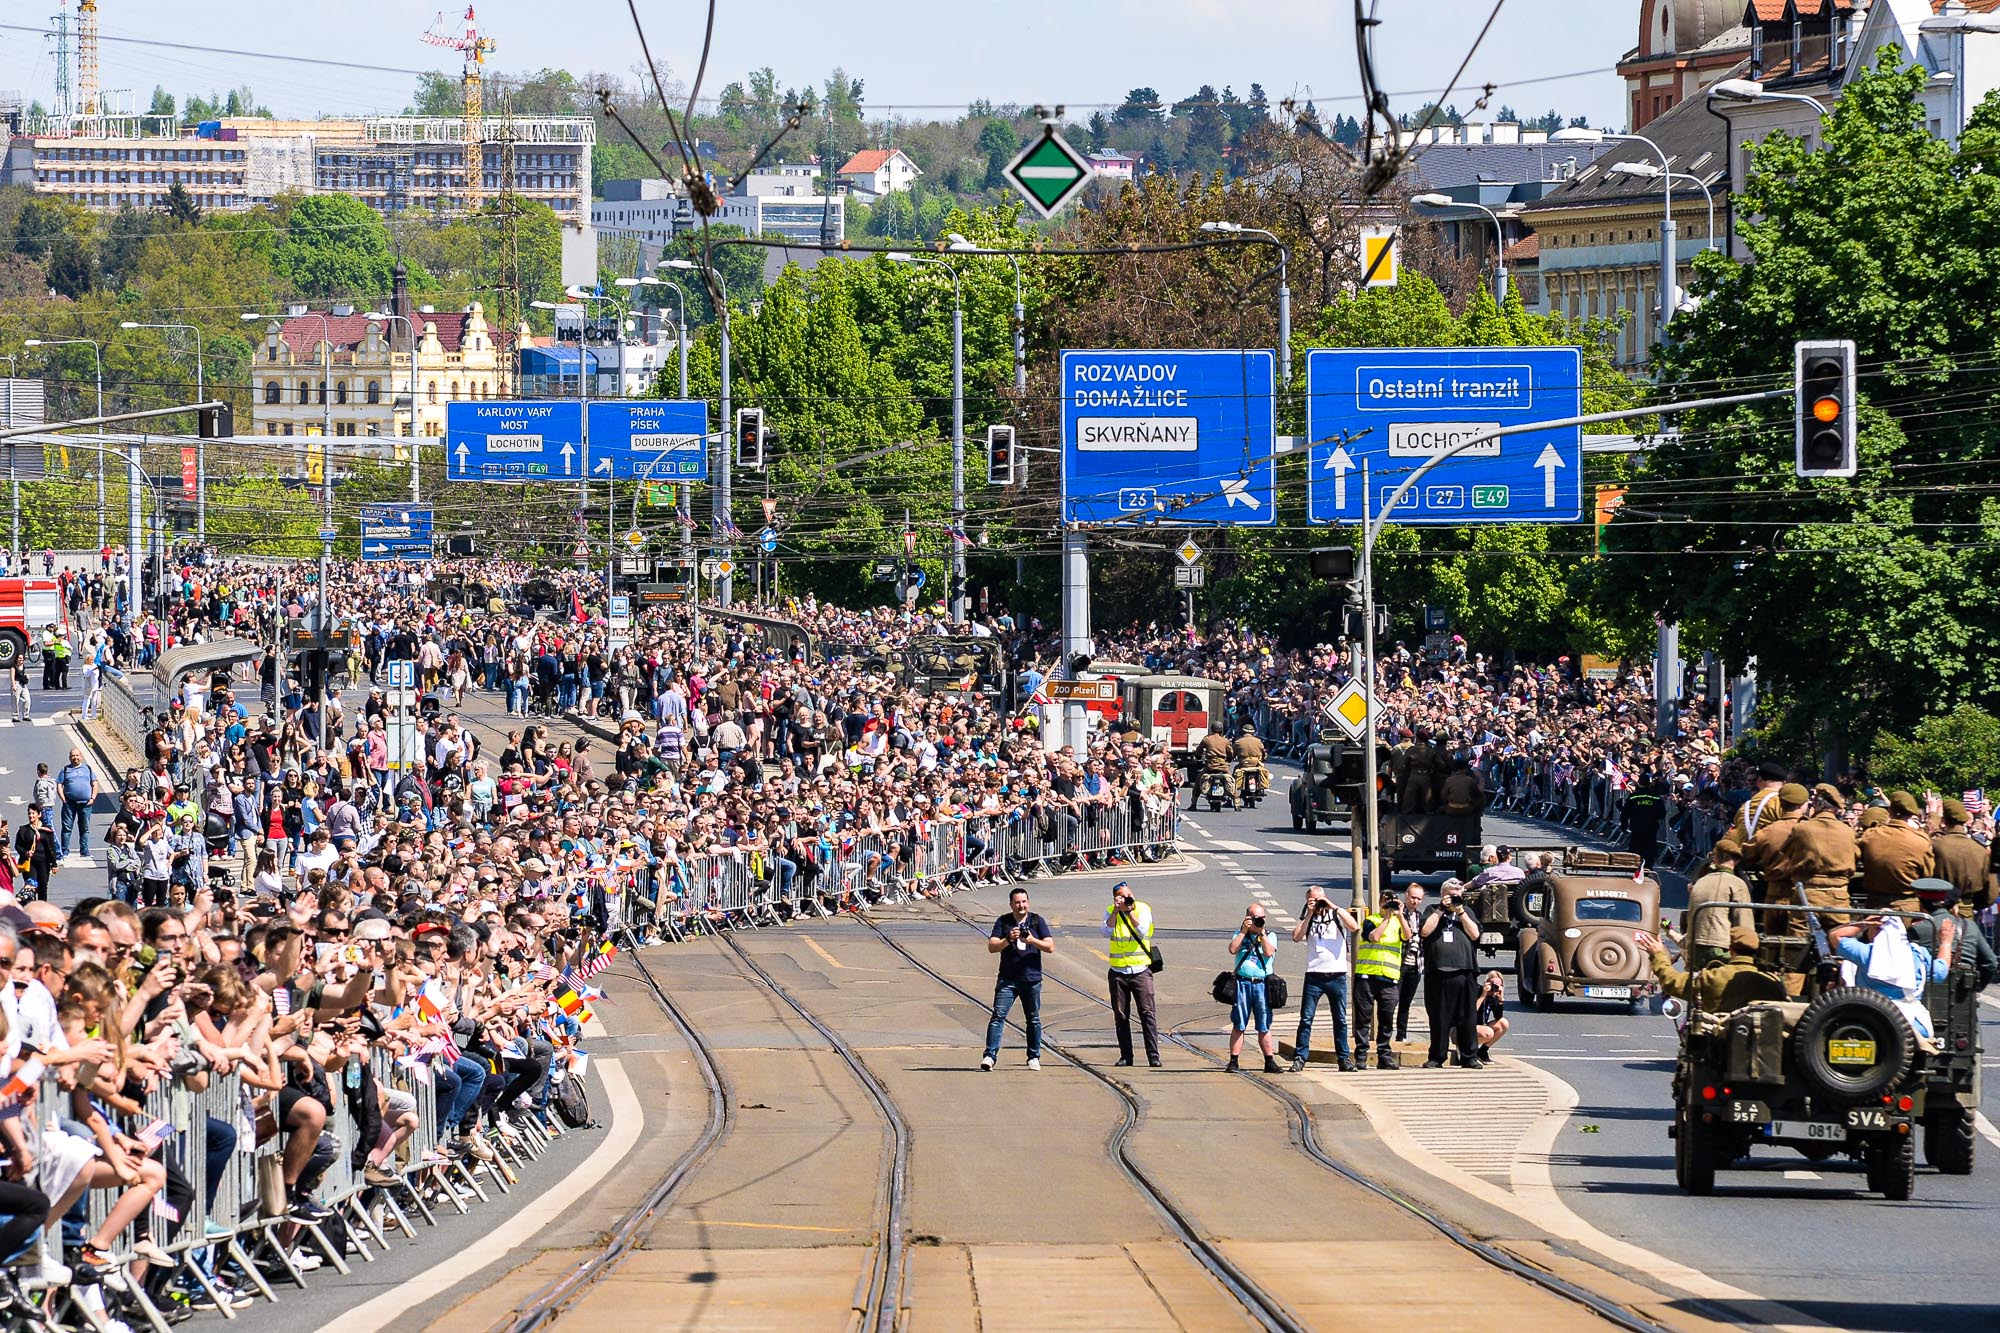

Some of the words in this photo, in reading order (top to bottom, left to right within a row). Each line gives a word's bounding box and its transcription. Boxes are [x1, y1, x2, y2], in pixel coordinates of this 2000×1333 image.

[1074, 364, 1178, 382] ROZVADOV
[1369, 377, 1446, 399] Ostatní
[1451, 377, 1520, 398] tranzit
[1075, 384, 1188, 407] DOMAŽLICE
[477, 407, 524, 417] KARLOVY
[527, 407, 553, 417] VARY
[630, 407, 666, 417] PRAHA
[500, 420, 529, 430] MOST
[630, 418, 660, 430] PÍSEK
[1084, 422, 1190, 443] SKVRŇANY
[490, 437, 540, 448] LOCHOTÍN
[530, 465, 546, 473] E49
[638, 464, 648, 472] 20
[661, 464, 671, 472] 26
[681, 464, 697, 472] E49
[1129, 492, 1147, 507] 26
[1391, 490, 1409, 504] 0
[1436, 490, 1454, 505] 27
[1475, 490, 1505, 504] E49
[1054, 685, 1070, 694] ZOO
[1073, 685, 1096, 695] Plzeň
[1847, 1111, 1886, 1127] SV4
[1774, 1122, 1783, 1135] V
[1808, 1124, 1842, 1138] 0814
